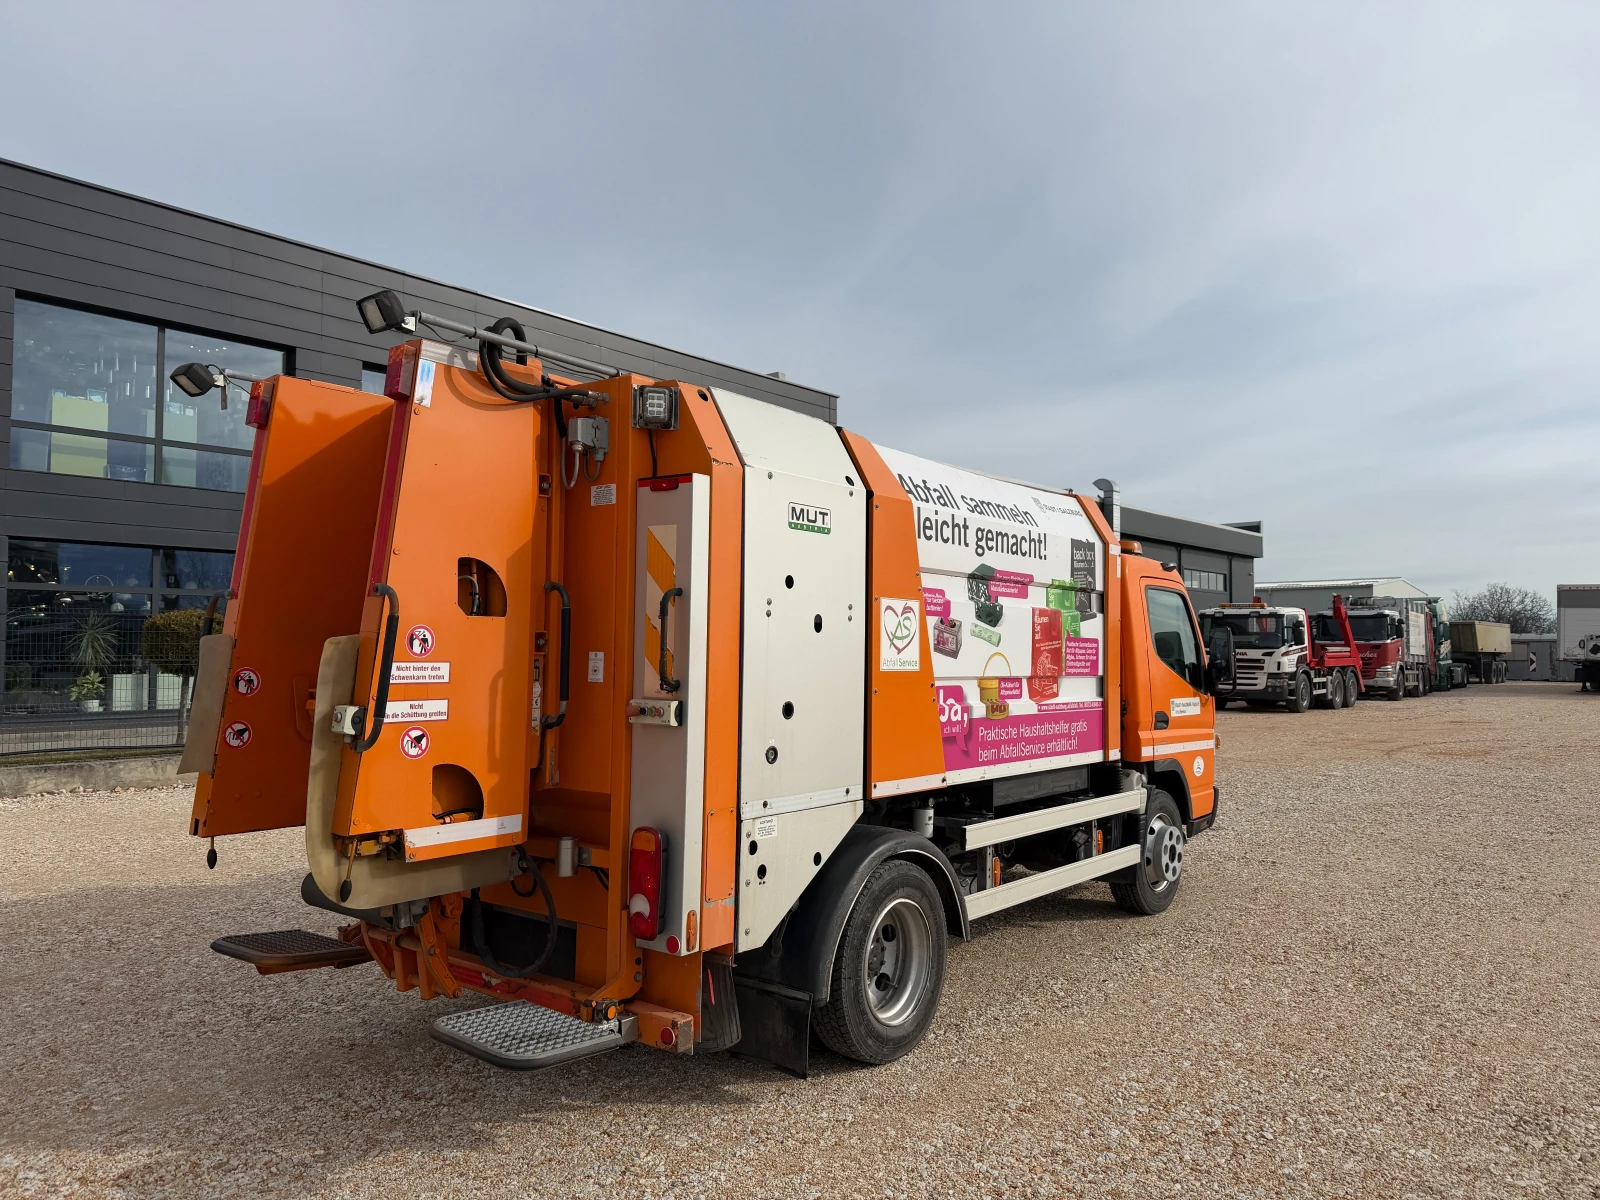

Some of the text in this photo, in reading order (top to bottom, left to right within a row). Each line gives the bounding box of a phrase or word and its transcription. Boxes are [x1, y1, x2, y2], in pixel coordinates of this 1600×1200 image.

[897, 473, 1040, 528] Abfall sammeln
[791, 506, 829, 526] MUT
[917, 506, 1047, 561] leicht gemacht!
[390, 673, 445, 681] Schwenkarm treten
[395, 664, 412, 672] Nicht
[412, 664, 430, 672] hinter
[391, 711, 400, 719] die
[400, 710, 428, 719] Schüttung
[428, 709, 447, 718] greifen
[939, 689, 968, 727] Ja,
[943, 724, 962, 734] ich will!
[979, 718, 1088, 742] Praktische Haushaltshelfer gratis
[978, 736, 1078, 762] beim AbfallService erhältlich!
